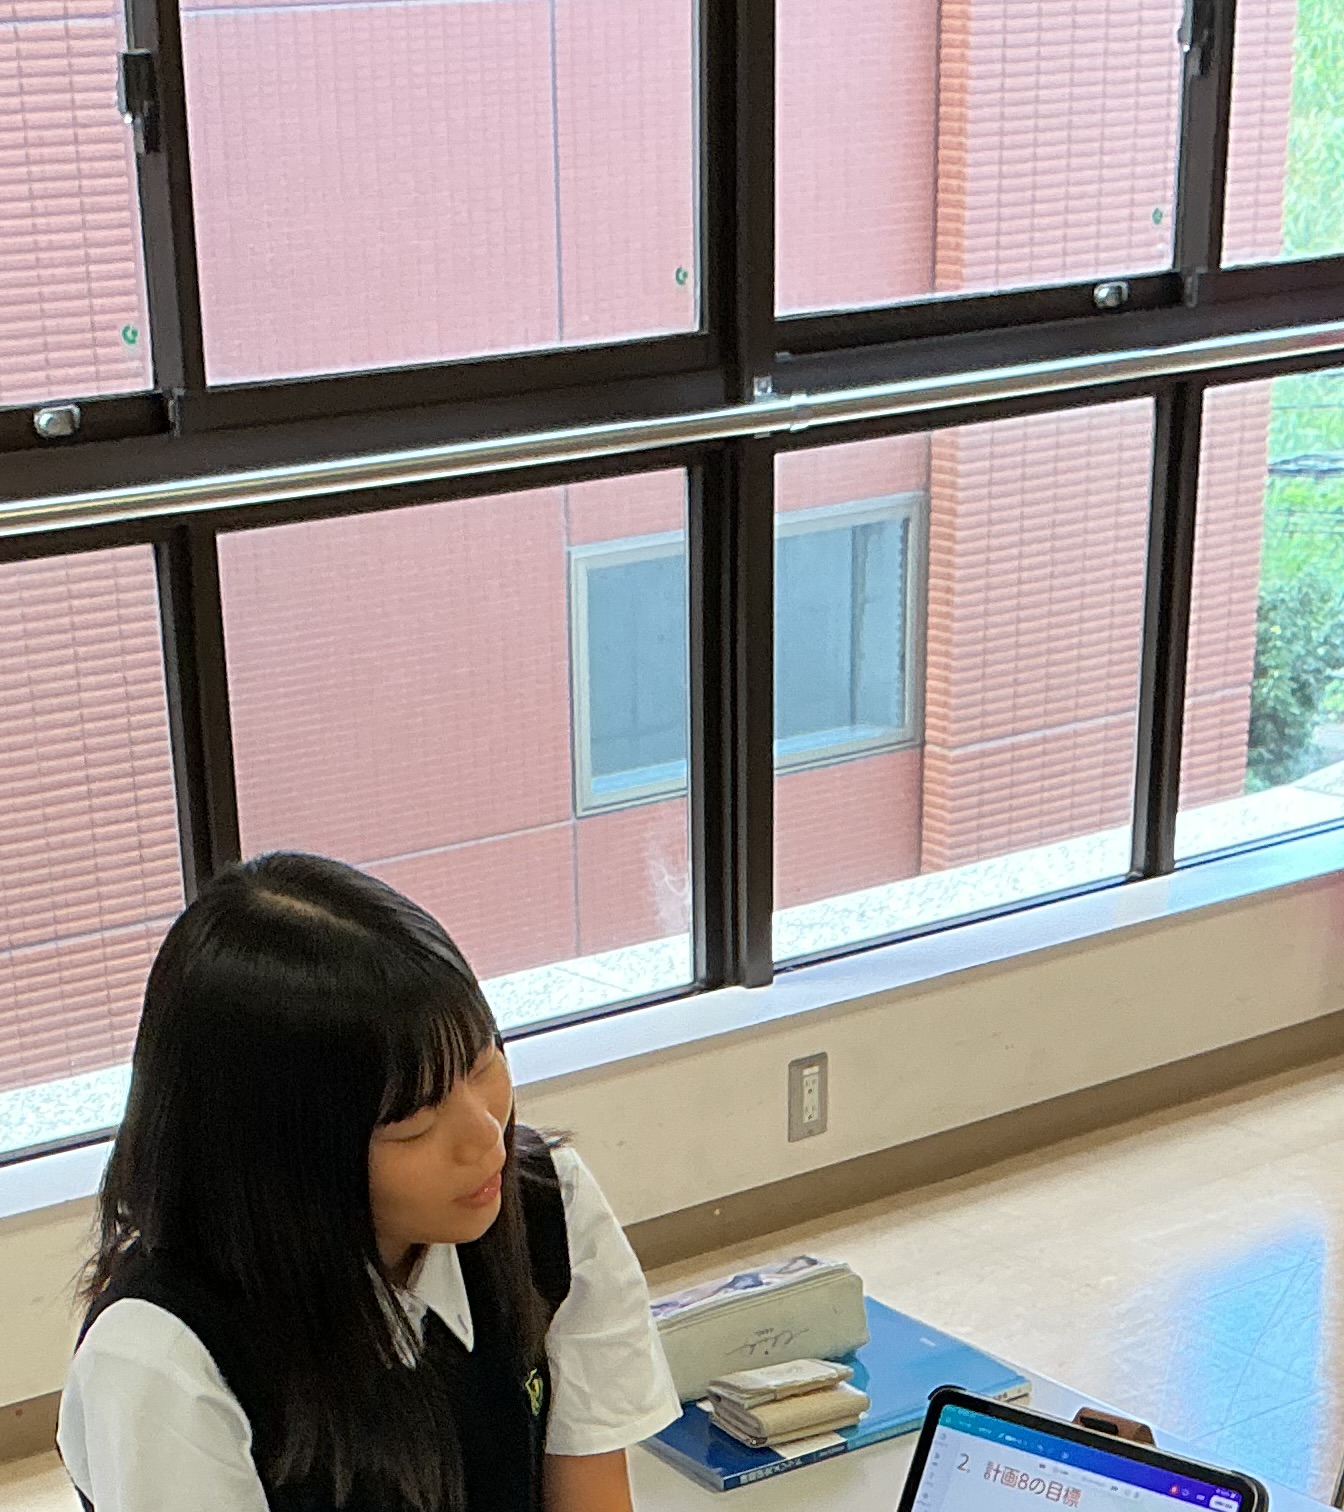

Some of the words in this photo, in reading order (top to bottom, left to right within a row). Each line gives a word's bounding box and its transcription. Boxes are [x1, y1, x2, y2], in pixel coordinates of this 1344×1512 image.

[983, 1460, 1082, 1508] 計画8の目標
